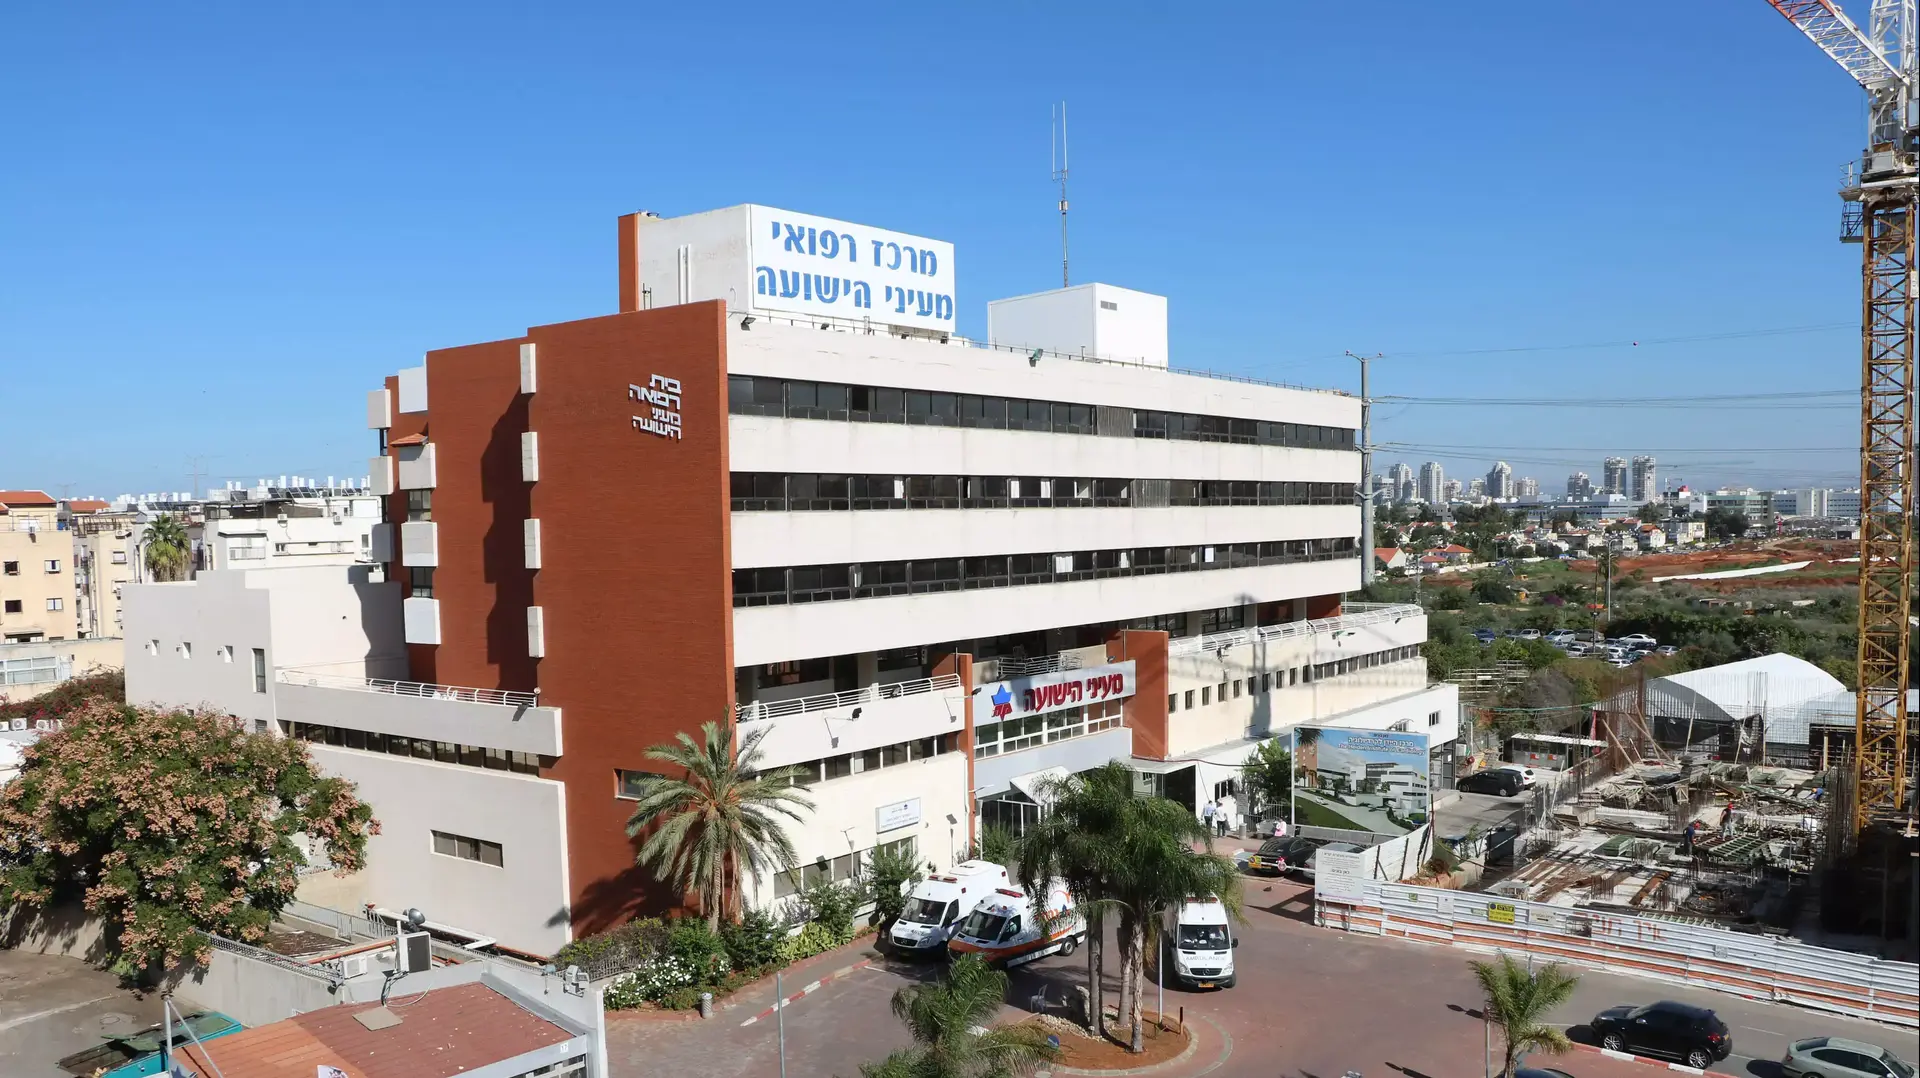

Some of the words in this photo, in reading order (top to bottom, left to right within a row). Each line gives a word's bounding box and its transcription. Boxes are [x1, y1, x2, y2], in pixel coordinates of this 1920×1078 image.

[771, 220, 857, 262] רפואי
[871, 239, 938, 277] מרכז
[755, 265, 871, 309] הישועה
[885, 285, 953, 321] מעיני
[629, 383, 681, 410] רפואה
[650, 373, 682, 395] בית
[632, 415, 682, 440] הישועה
[652, 407, 682, 427] מעיני
[1023, 680, 1083, 713] הישועה
[1086, 673, 1124, 700] מעיני
